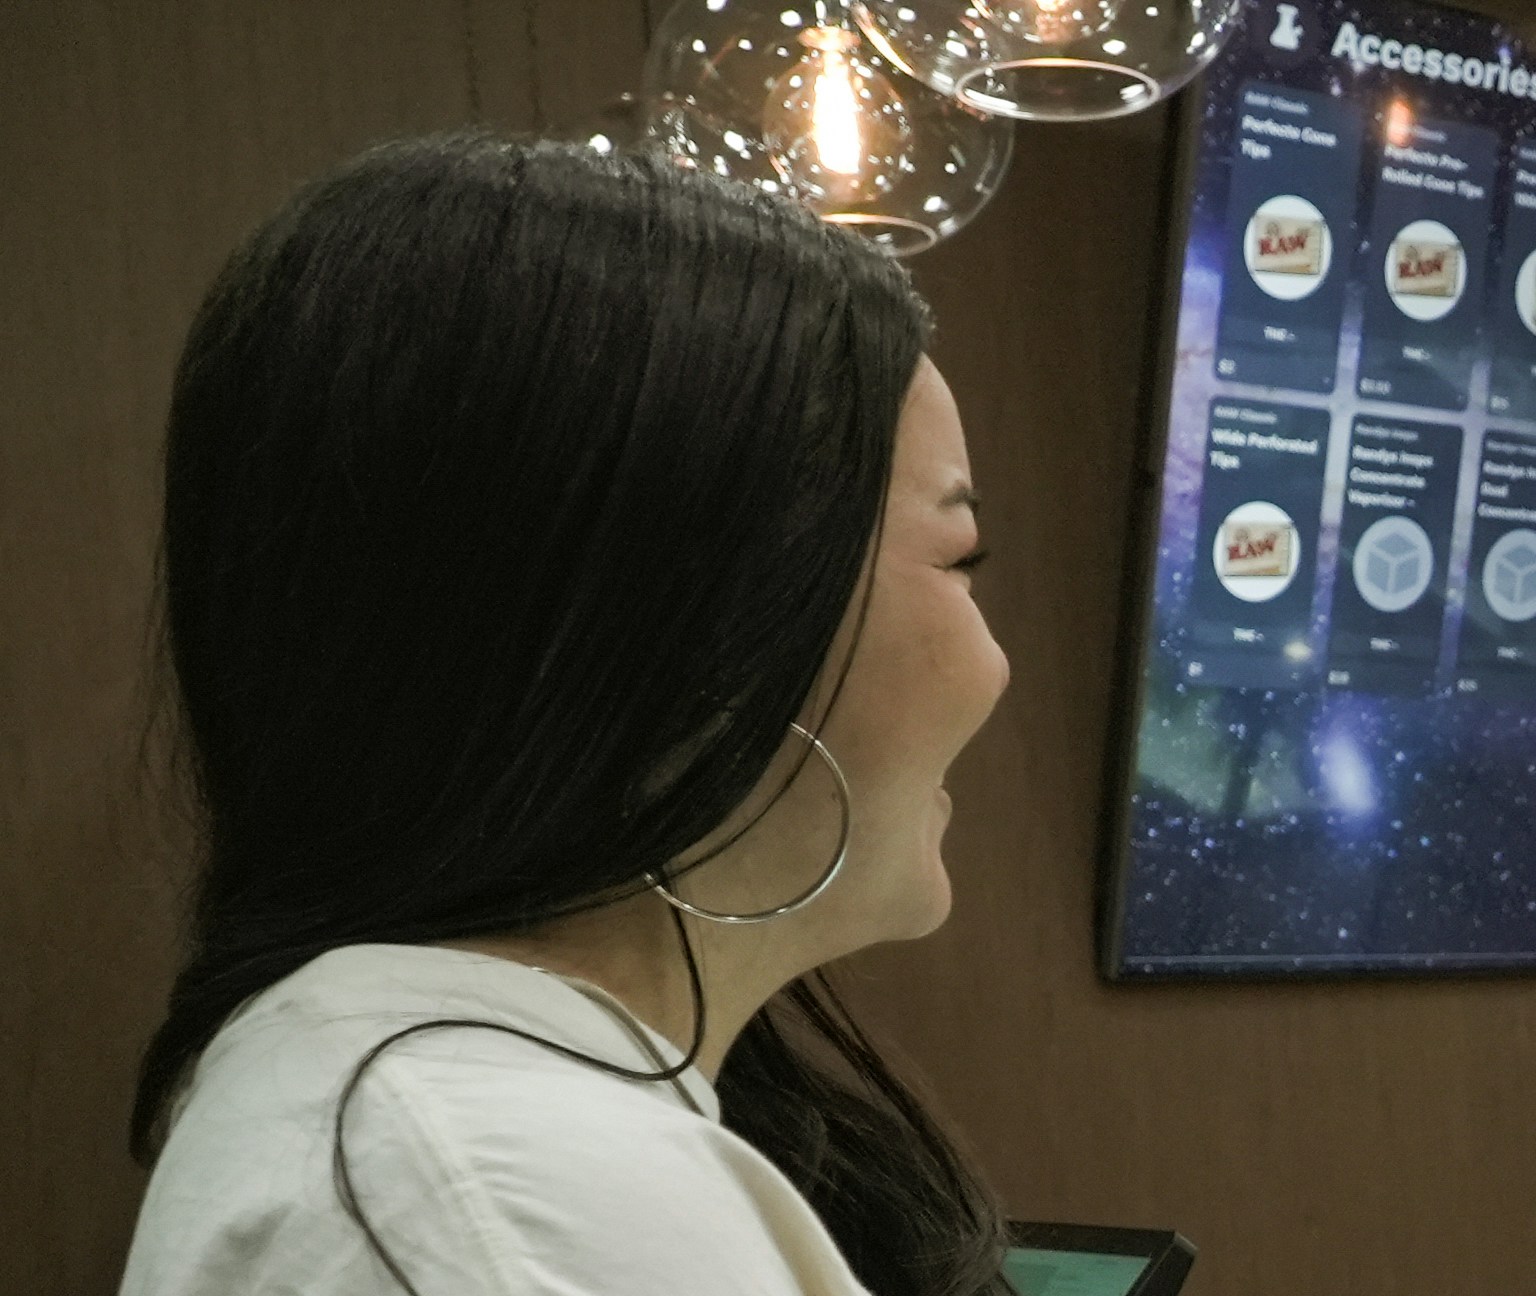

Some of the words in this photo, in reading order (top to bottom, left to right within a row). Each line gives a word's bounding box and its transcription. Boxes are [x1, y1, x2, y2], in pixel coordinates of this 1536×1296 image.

[1241, 138, 1271, 160] Tips
[1457, 179, 1484, 199] Tips
[1212, 427, 1247, 447] Wide
[1248, 432, 1319, 455] Perforated
[1210, 450, 1240, 470] Tips
